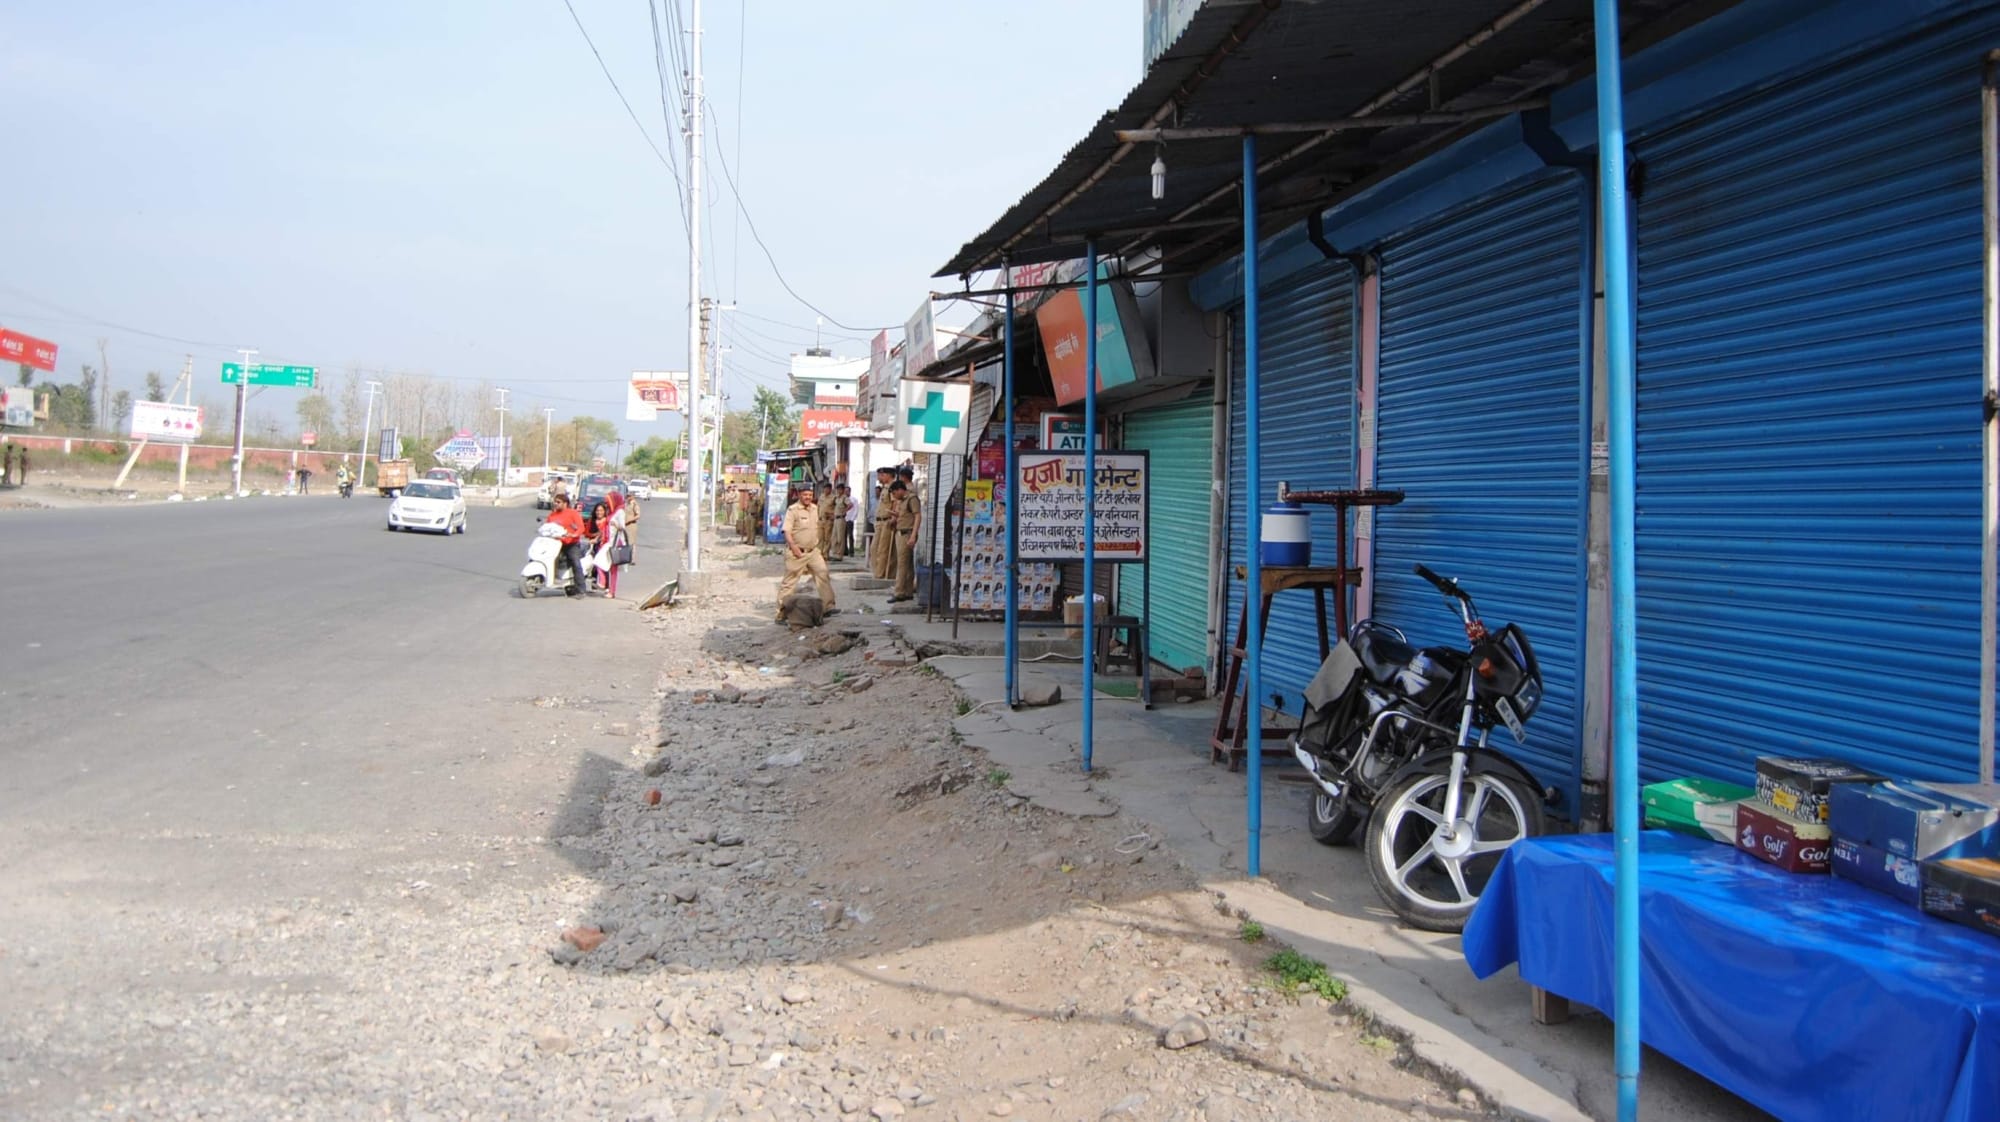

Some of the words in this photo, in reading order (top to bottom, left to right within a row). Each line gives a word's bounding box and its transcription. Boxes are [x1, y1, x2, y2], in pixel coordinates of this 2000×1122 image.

[1021, 458, 1062, 493] पूजा
[1763, 835, 1786, 858] Golf
[1799, 847, 1830, 861] Gol
